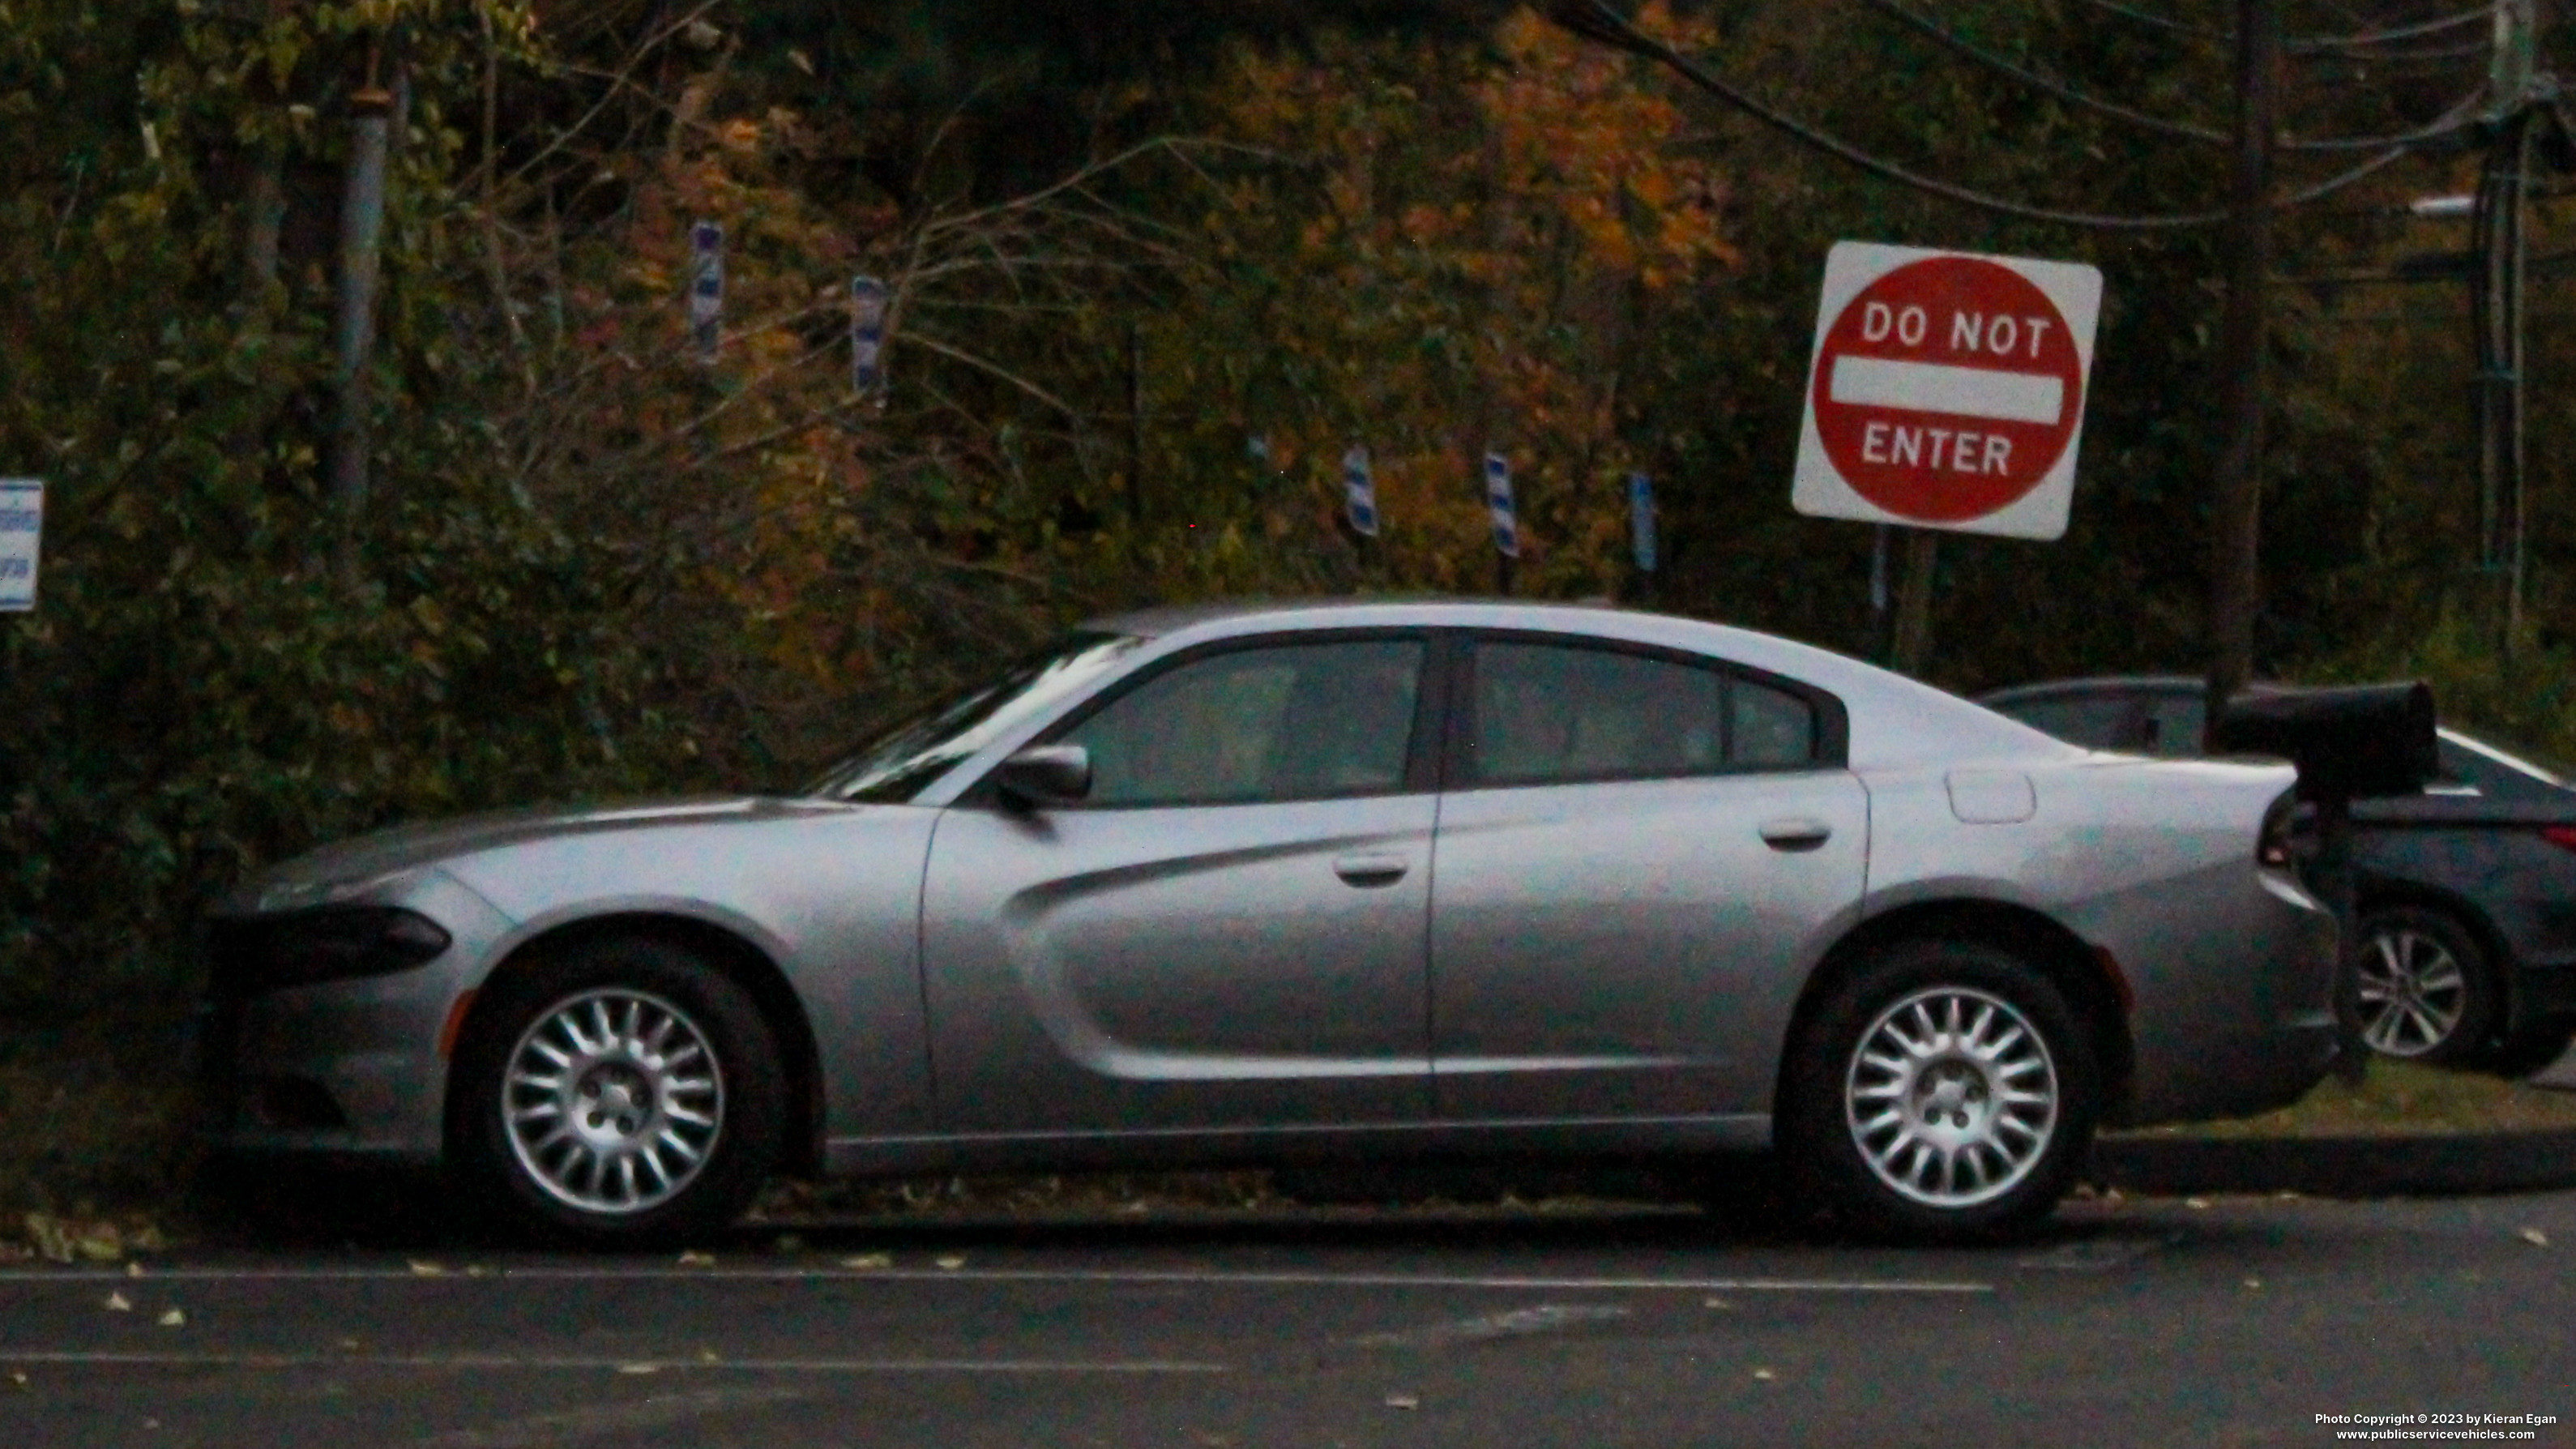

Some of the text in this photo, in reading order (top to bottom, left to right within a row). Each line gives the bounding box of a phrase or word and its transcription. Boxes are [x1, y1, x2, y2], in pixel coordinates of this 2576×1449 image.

[1863, 301, 2052, 357] DO NOT
[1863, 422, 2013, 476] ENTER
